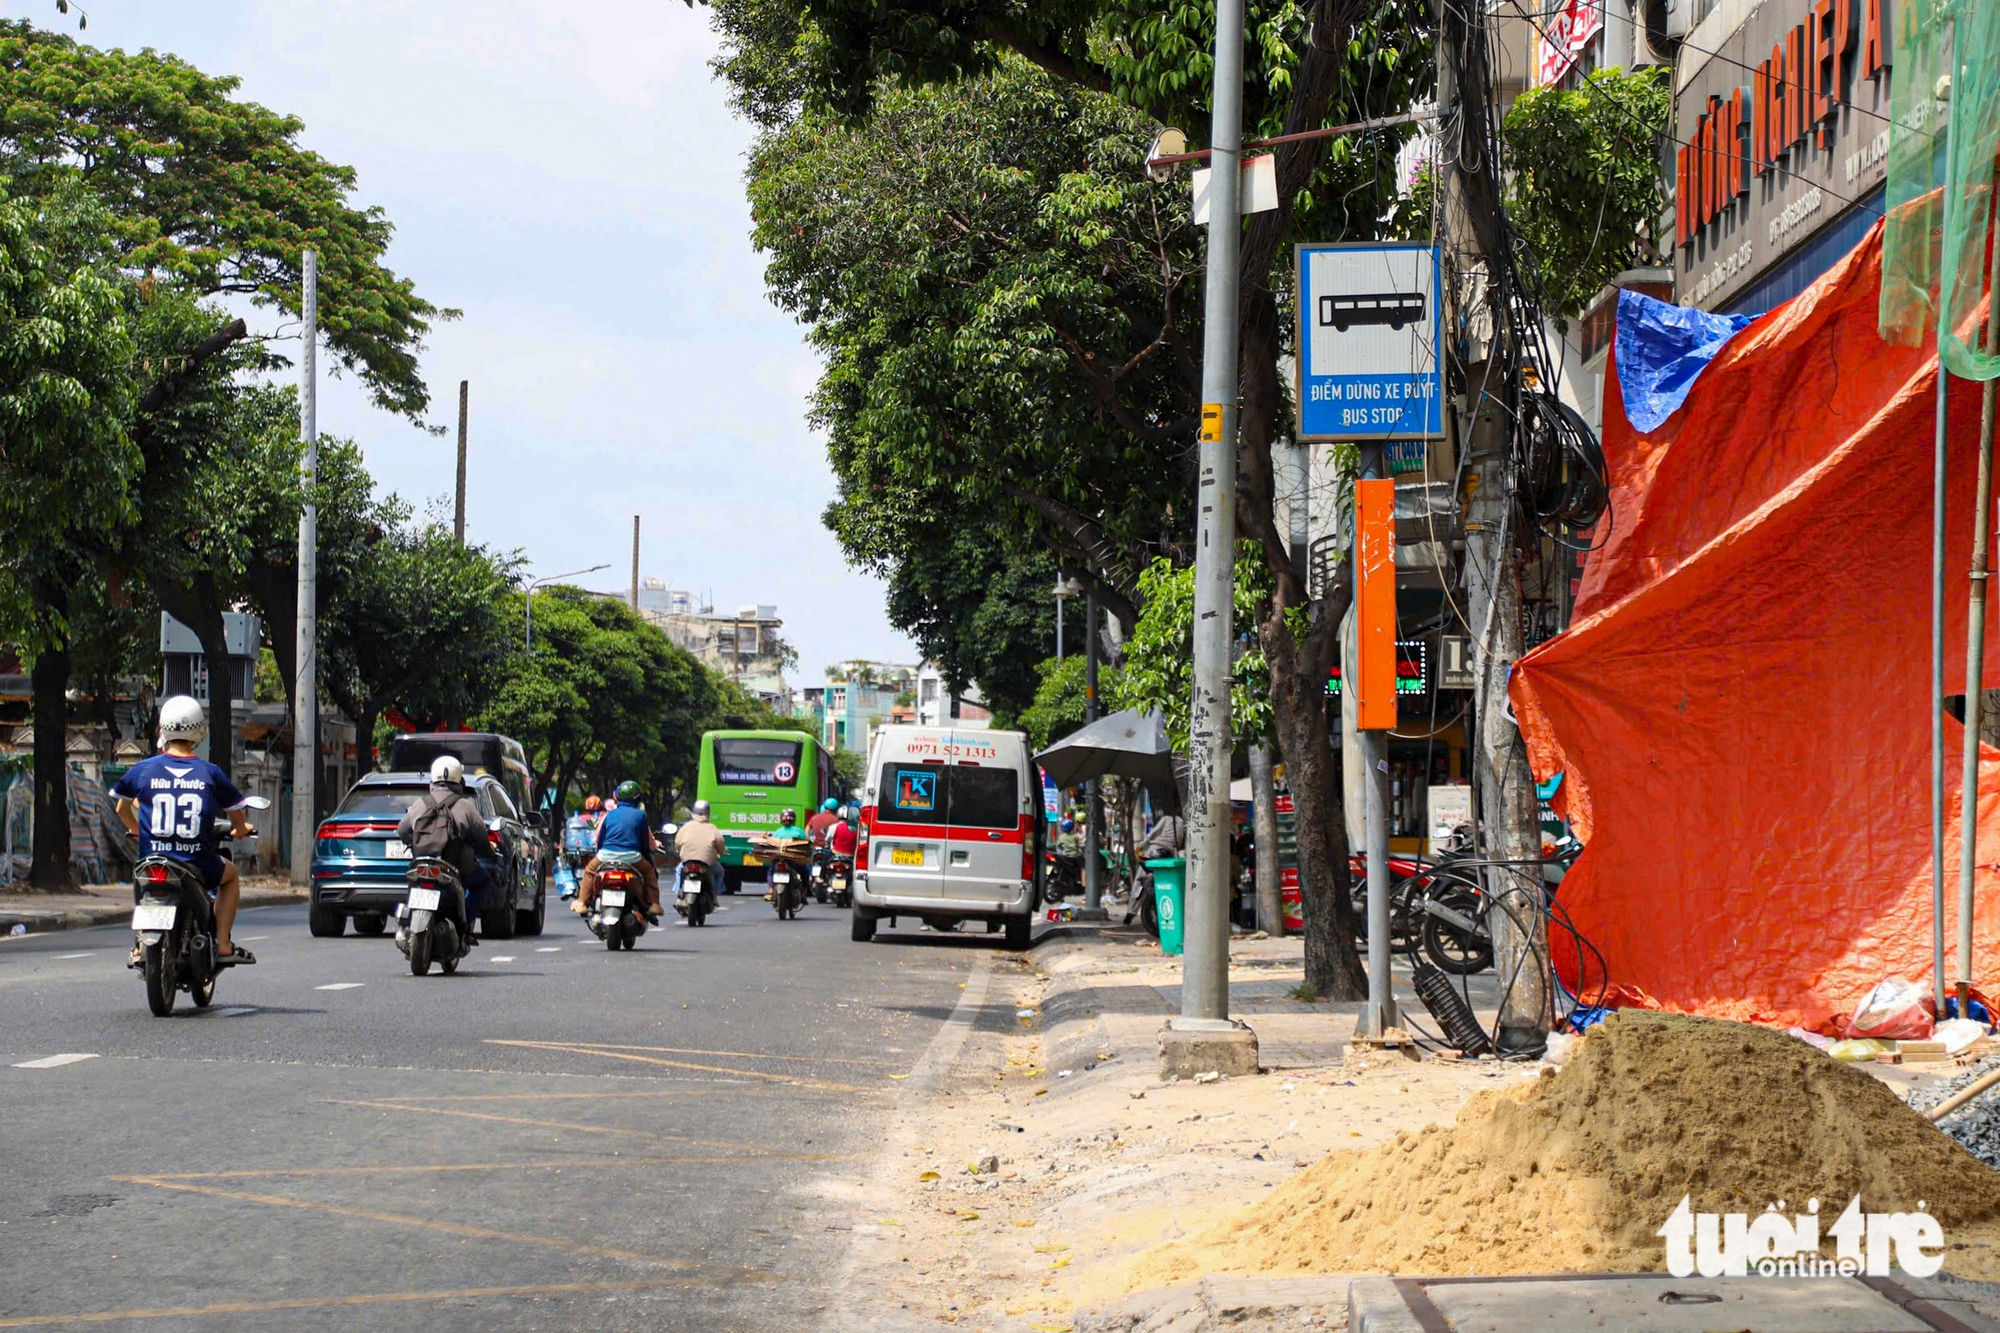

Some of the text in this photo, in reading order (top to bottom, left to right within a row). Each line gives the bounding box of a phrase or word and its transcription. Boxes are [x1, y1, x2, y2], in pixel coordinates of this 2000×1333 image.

[1311, 377, 1435, 401] ĐIỂM DỪNG XE BUÝT
[1343, 408, 1403, 424] BUS STOP
[907, 744, 996, 759] 0971 52 1313
[778, 766, 791, 778] 13
[151, 778, 206, 790] Hữu Phước
[151, 793, 203, 838] 03
[731, 812, 781, 824] 51B-309.23
[151, 840, 201, 854] The boyz
